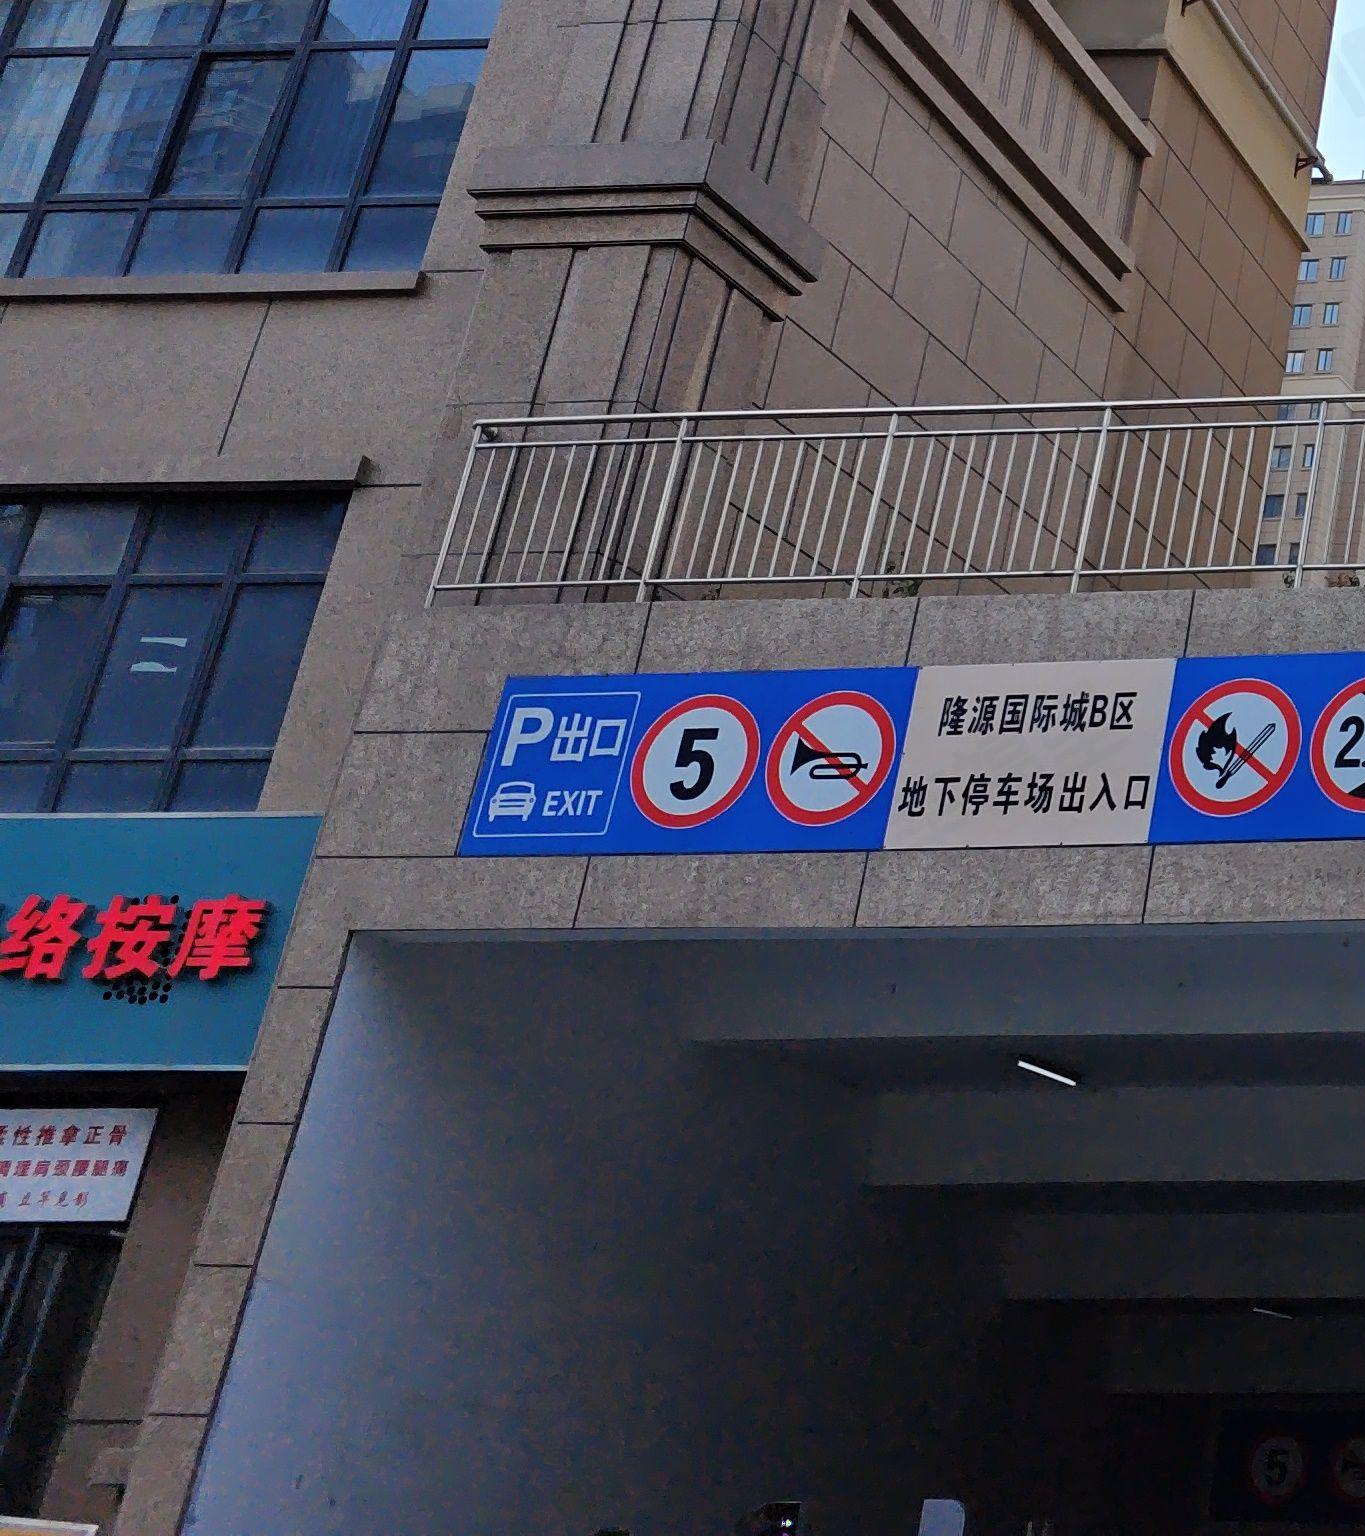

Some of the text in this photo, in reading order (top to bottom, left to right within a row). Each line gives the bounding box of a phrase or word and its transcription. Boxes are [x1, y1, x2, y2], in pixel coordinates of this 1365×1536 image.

[937, 690, 1138, 737] 隆源国际城B区
[669, 727, 719, 801] 5
[541, 790, 603, 817] EXIT
[898, 771, 1150, 817] 地下停车场出入口
[0, 893, 267, 981] 络按摩
